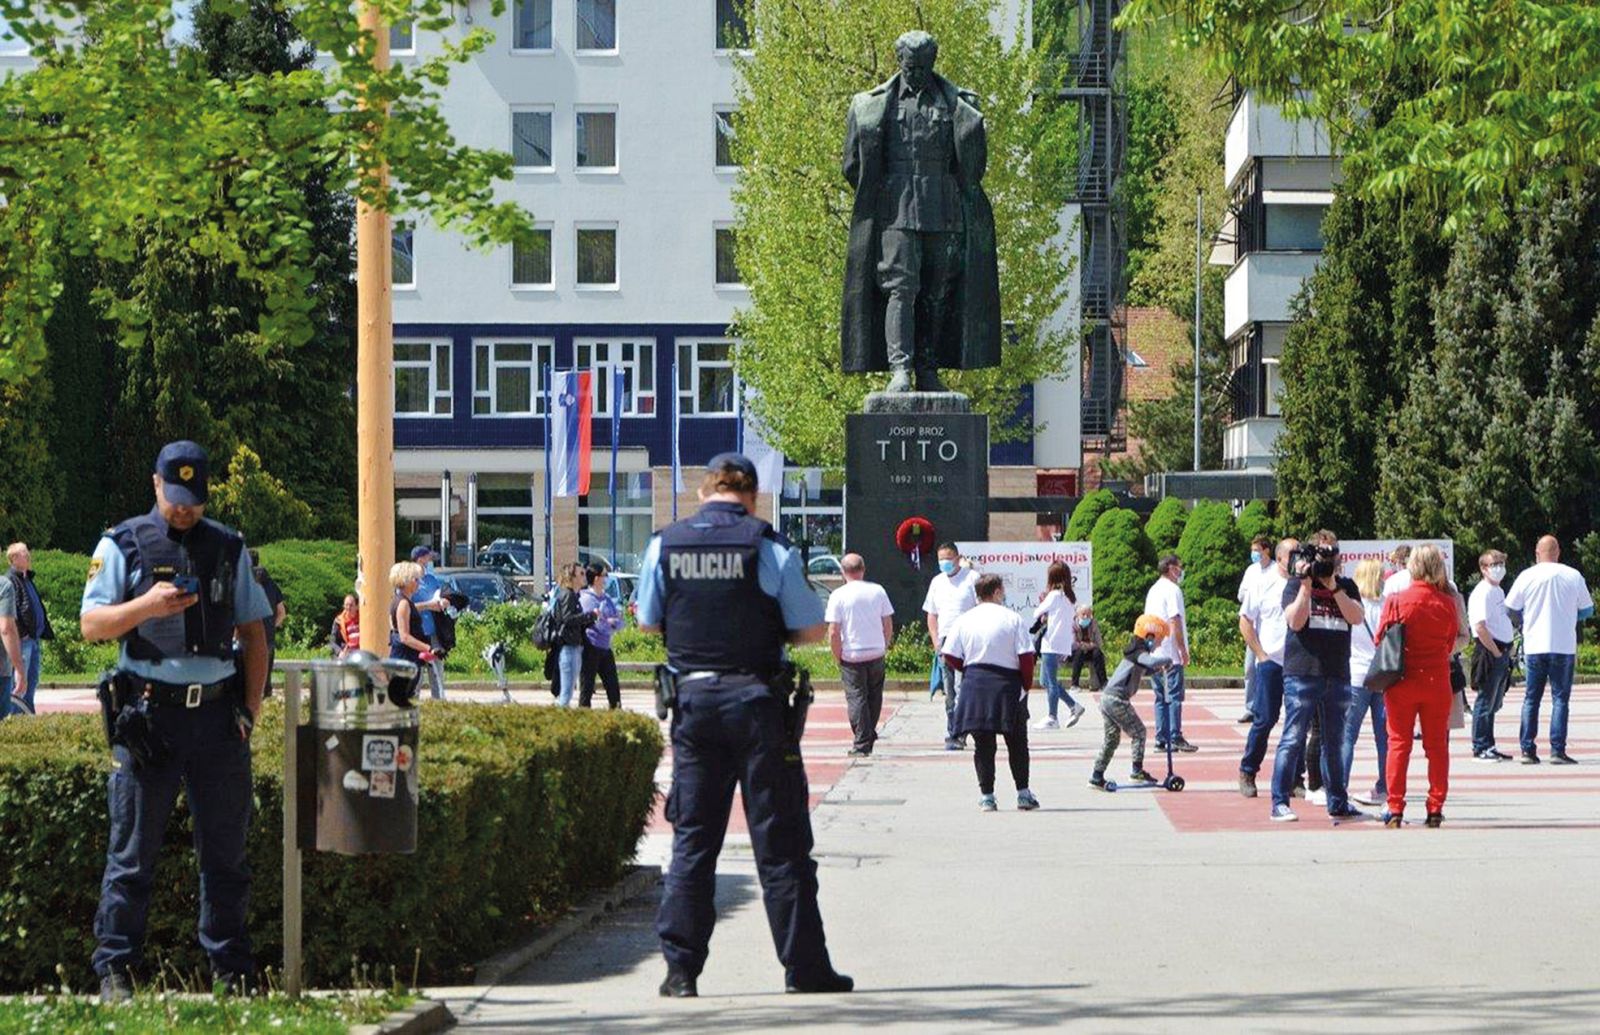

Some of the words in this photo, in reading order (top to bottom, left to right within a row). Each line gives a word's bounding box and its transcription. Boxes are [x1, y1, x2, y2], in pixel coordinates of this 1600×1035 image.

[888, 426, 916, 437] JOSIP
[918, 426, 945, 437] BROZ
[876, 440, 958, 462] TITO
[890, 475, 912, 484] 1892
[922, 475, 944, 484] 1980
[669, 552, 744, 579] POLICIJA
